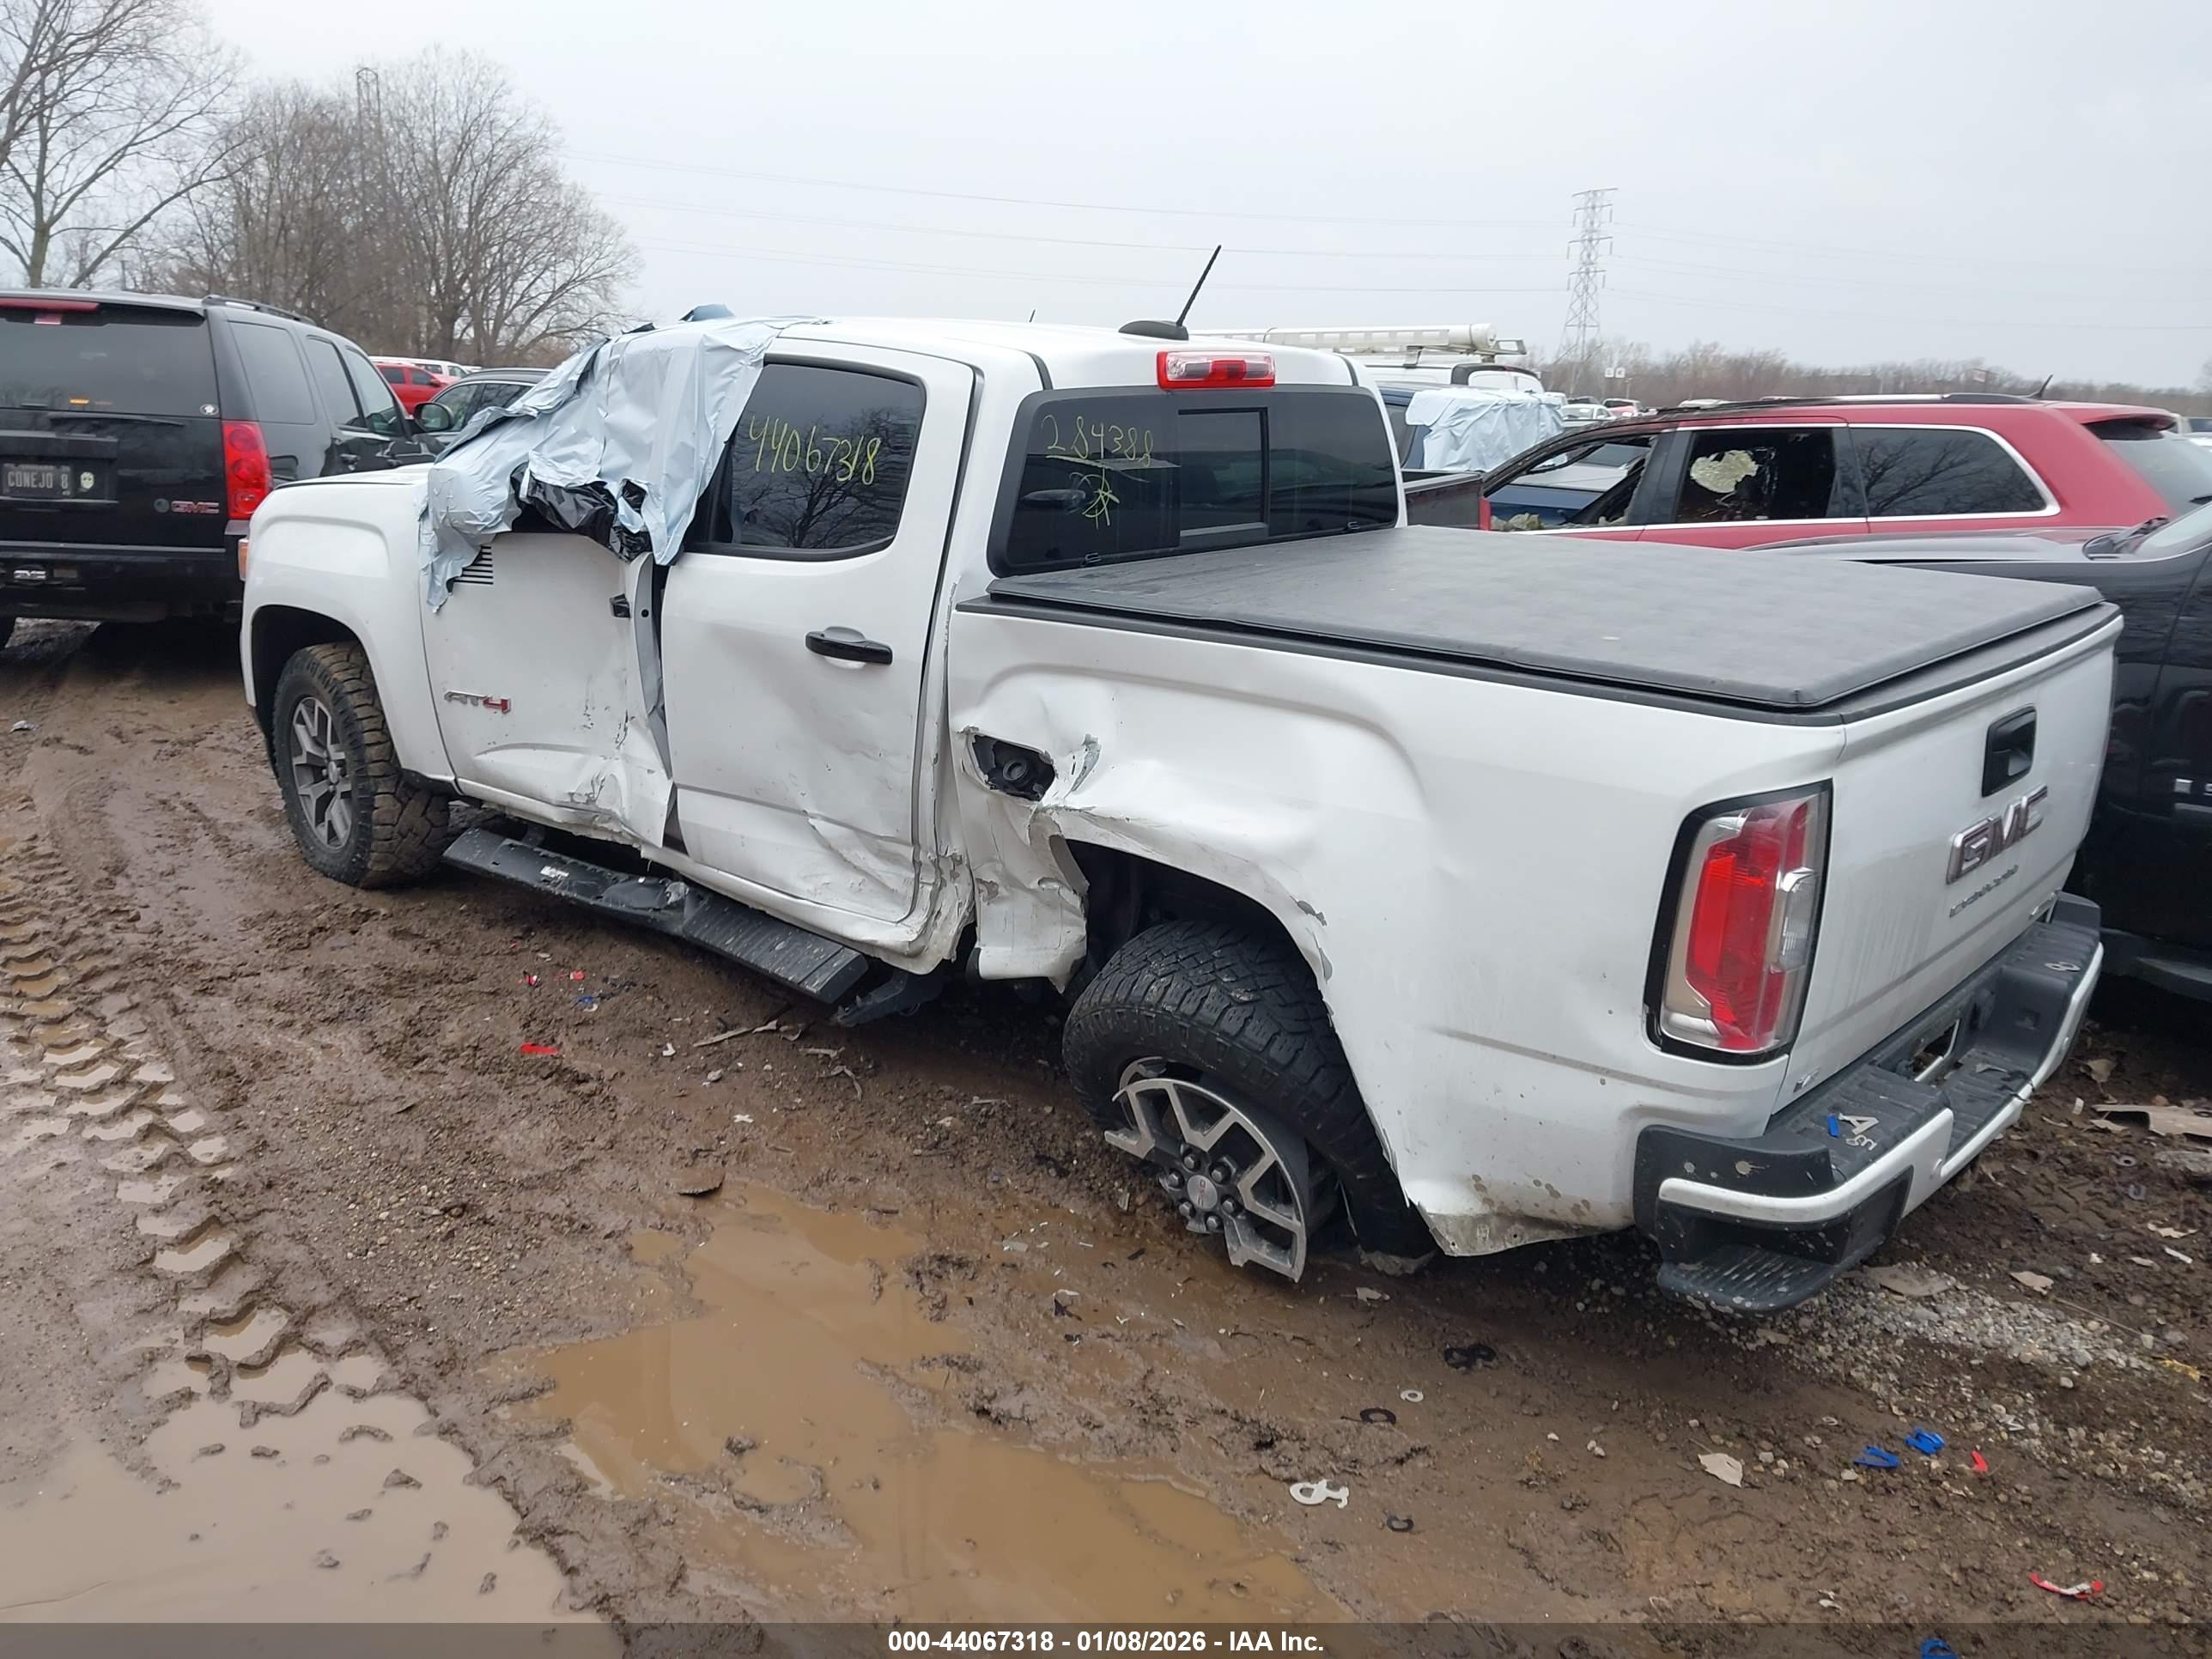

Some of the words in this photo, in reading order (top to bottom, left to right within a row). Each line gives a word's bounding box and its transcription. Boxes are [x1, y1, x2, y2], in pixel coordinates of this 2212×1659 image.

[749, 415, 881, 485] 44067318
[1041, 414, 1154, 468] 284388
[7, 471, 53, 489] CONEJO
[60, 473, 69, 489] 8
[171, 500, 220, 514] GMC
[1945, 782, 2049, 885] GMC
